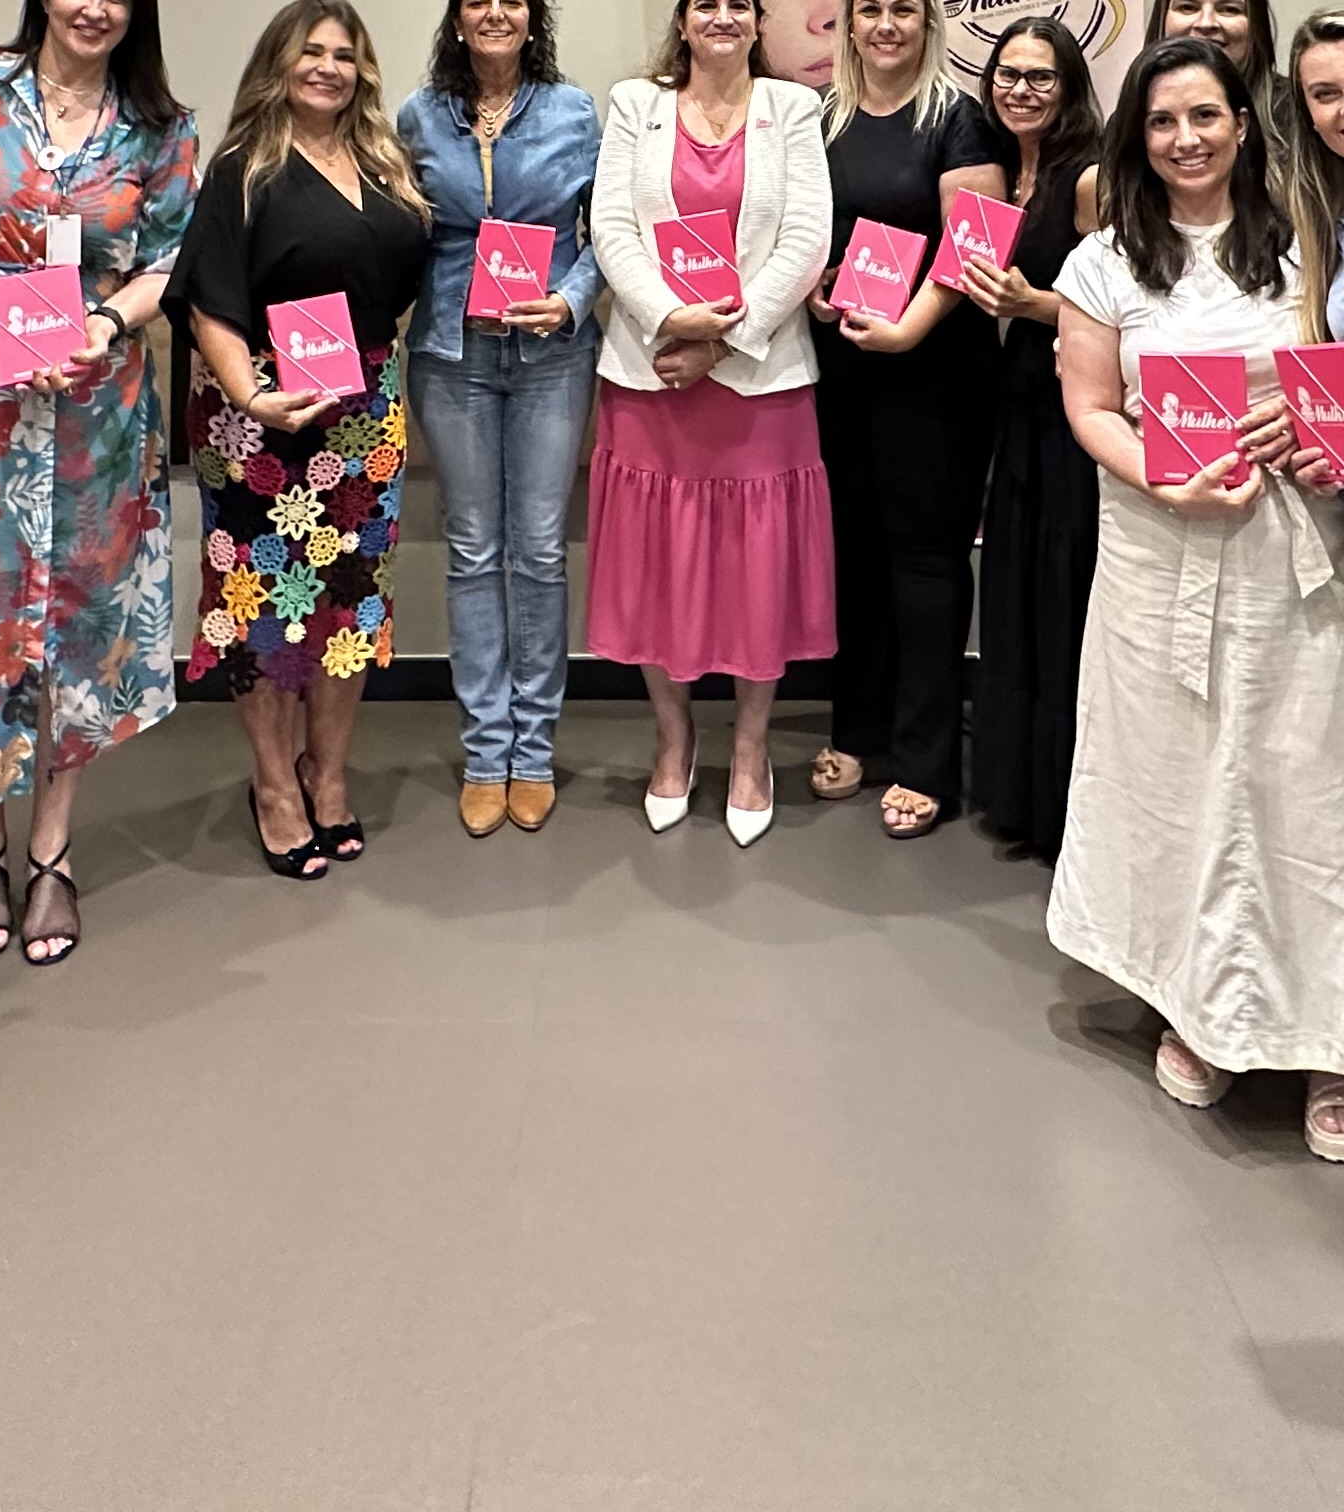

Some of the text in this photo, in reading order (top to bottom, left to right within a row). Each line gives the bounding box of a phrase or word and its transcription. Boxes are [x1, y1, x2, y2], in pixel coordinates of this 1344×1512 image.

[686, 256, 725, 272] Mulher
[864, 262, 902, 284] Mulher
[1179, 409, 1238, 430] Mulher
